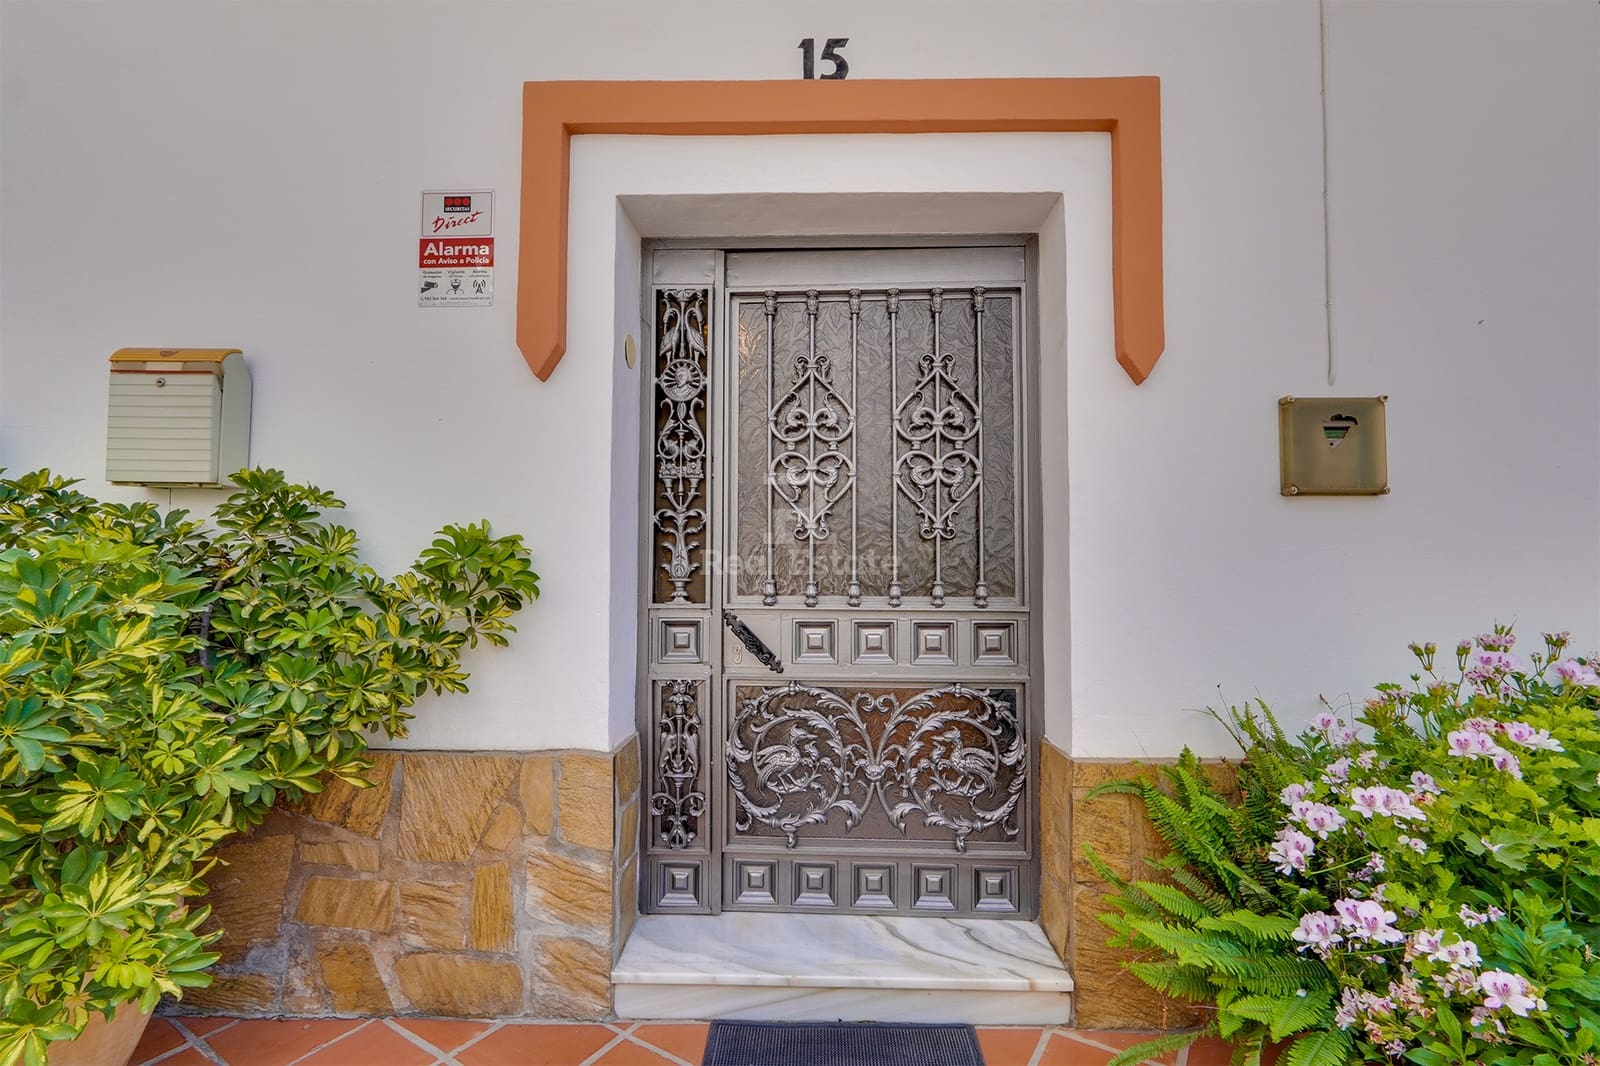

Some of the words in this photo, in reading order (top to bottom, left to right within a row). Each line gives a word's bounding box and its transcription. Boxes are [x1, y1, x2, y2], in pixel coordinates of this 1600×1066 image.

[797, 38, 850, 80] 15
[432, 211, 484, 233] Direct
[423, 241, 490, 256] Alarma
[438, 257, 458, 265] Aviso
